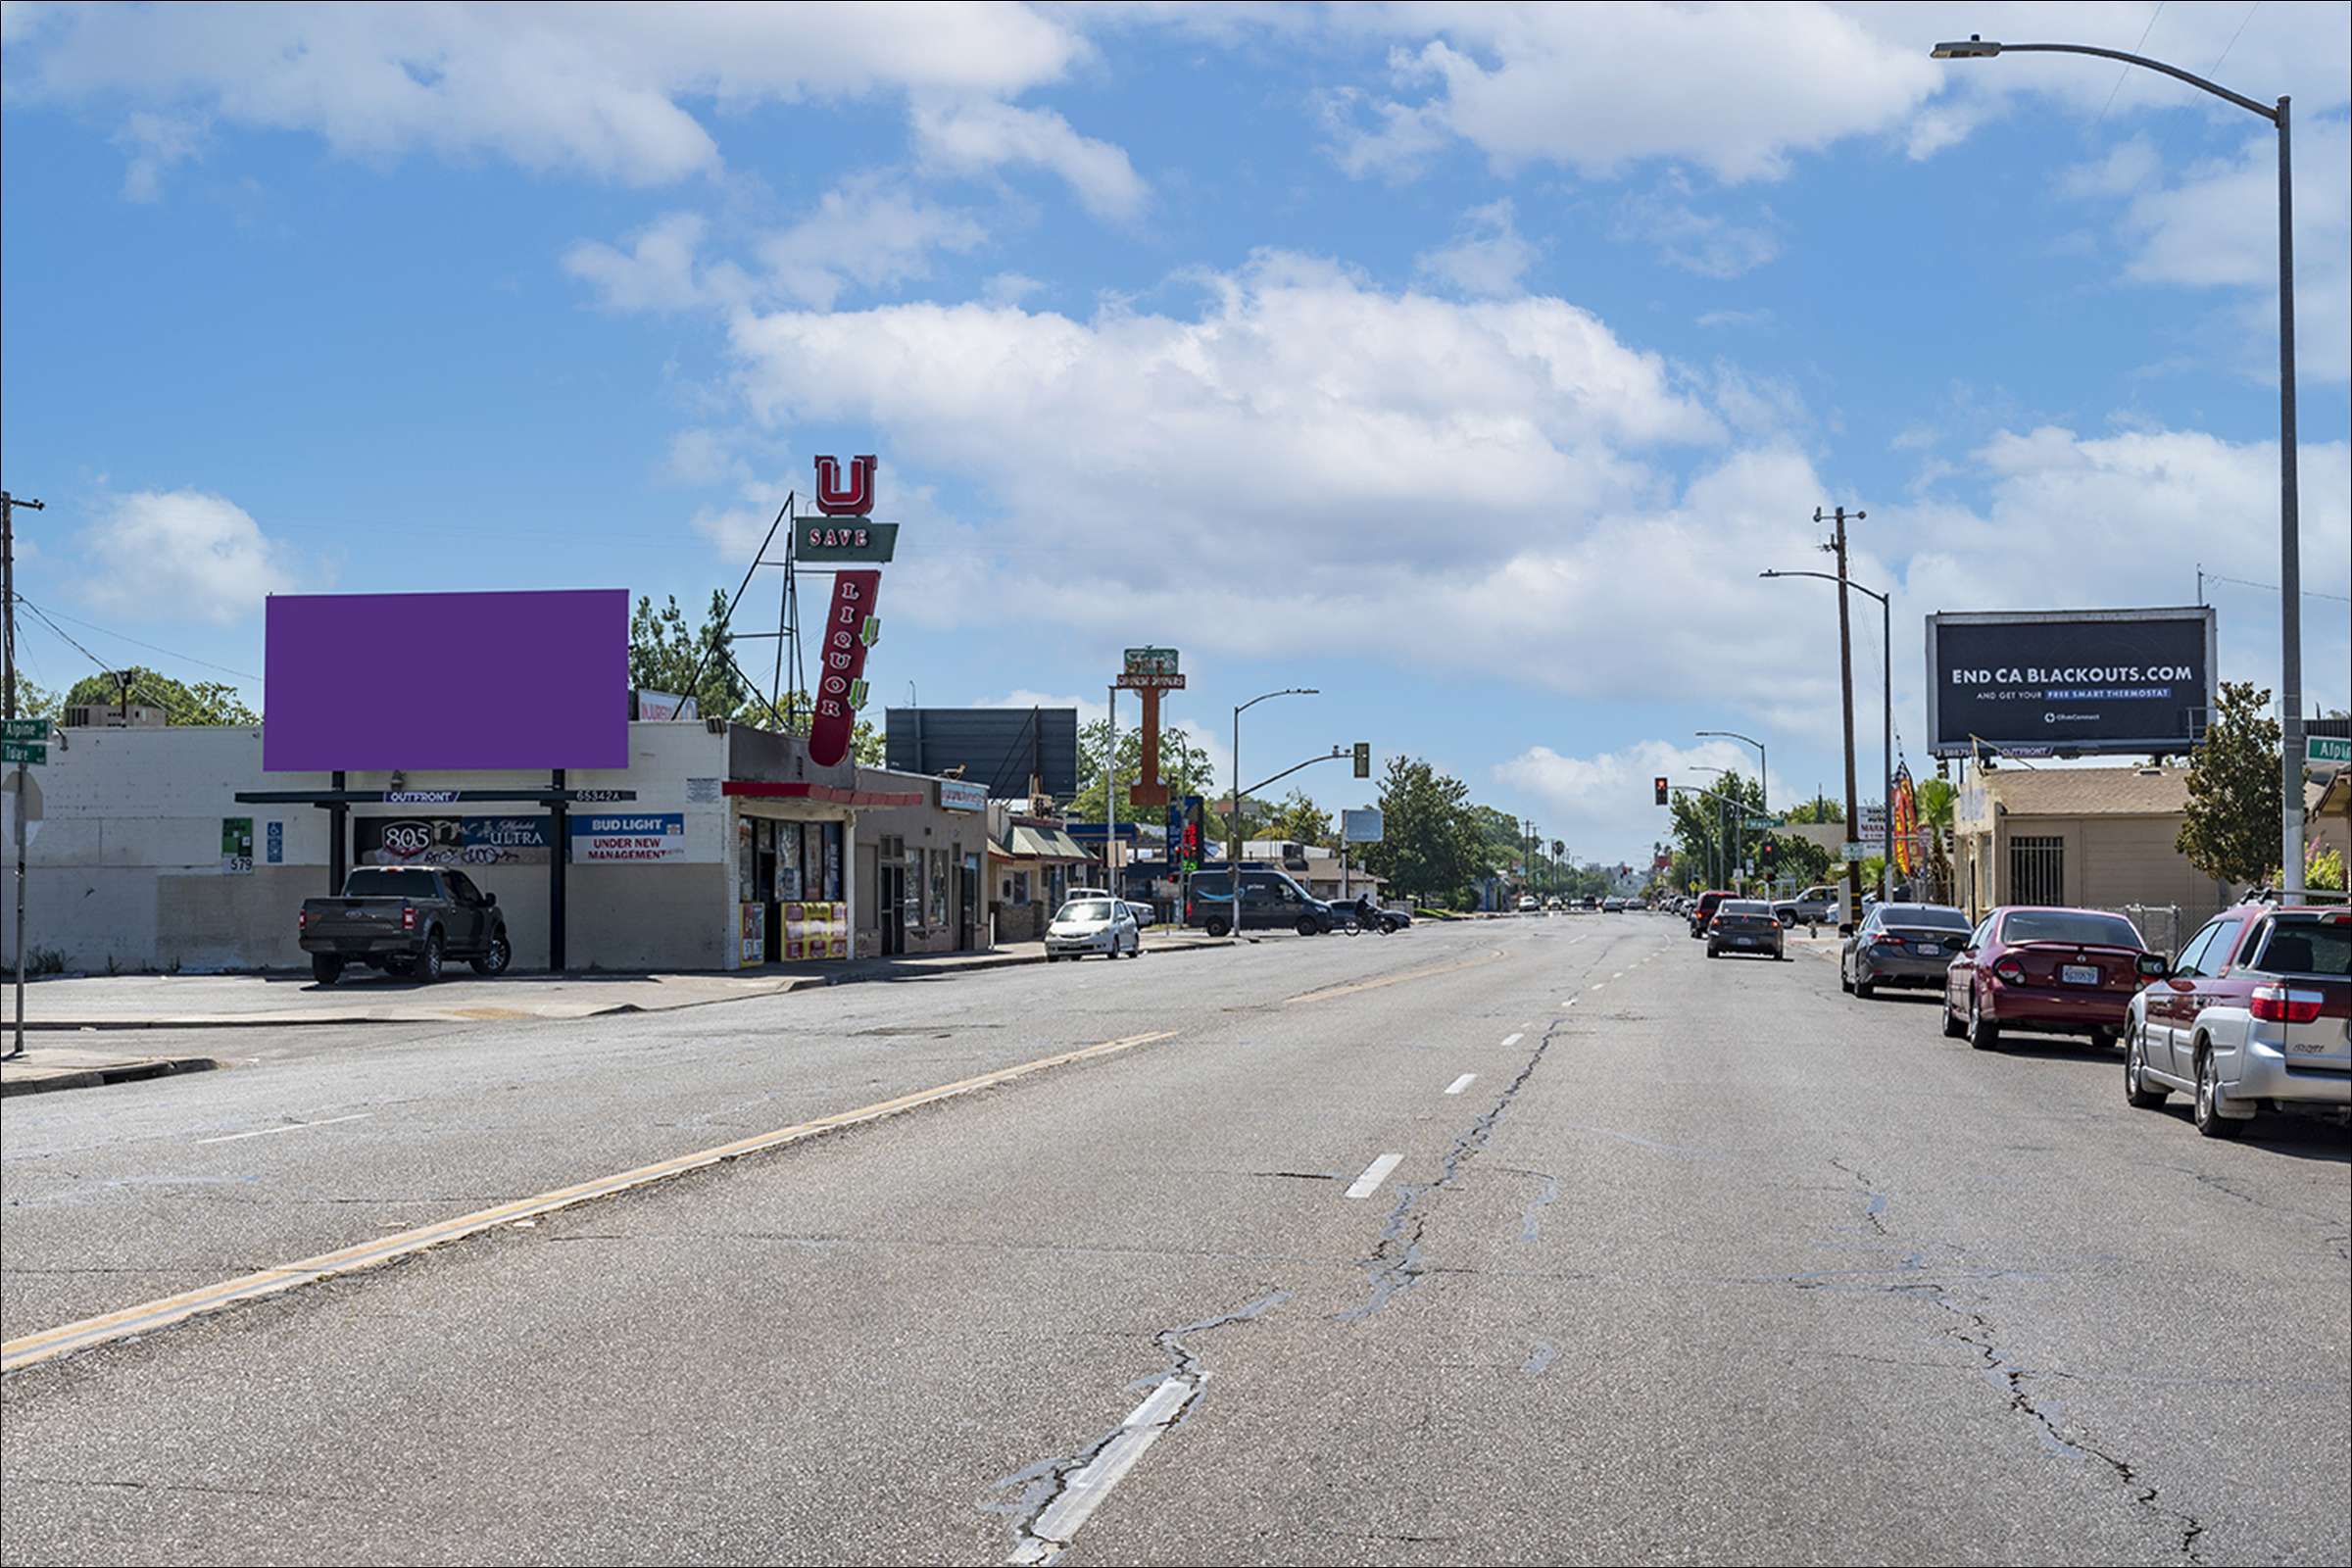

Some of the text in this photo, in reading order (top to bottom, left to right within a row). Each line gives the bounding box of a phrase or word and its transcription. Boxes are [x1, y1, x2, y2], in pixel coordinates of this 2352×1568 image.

[815, 455, 876, 514] U
[809, 529, 867, 546] SAVE
[821, 582, 859, 717] LIQUOR
[1952, 666, 2192, 684] END CA BLACKOUTS.COM
[1999, 691, 2016, 700] GET
[2047, 689, 2069, 698] FREE
[2072, 689, 2104, 698] SMART
[2106, 688, 2169, 698] THERMOSTAT
[5, 723, 36, 739] Alpine
[6, 745, 28, 760] Tulare
[390, 791, 620, 802] OUTFRONT 65342A
[592, 819, 620, 831] BUD
[622, 818, 662, 830] LIGHT
[386, 827, 429, 848] 805
[490, 832, 544, 845] ULTRA
[593, 838, 662, 849] UNDER NEW
[588, 850, 666, 859] MANAGEMENT
[230, 858, 252, 870] 579
